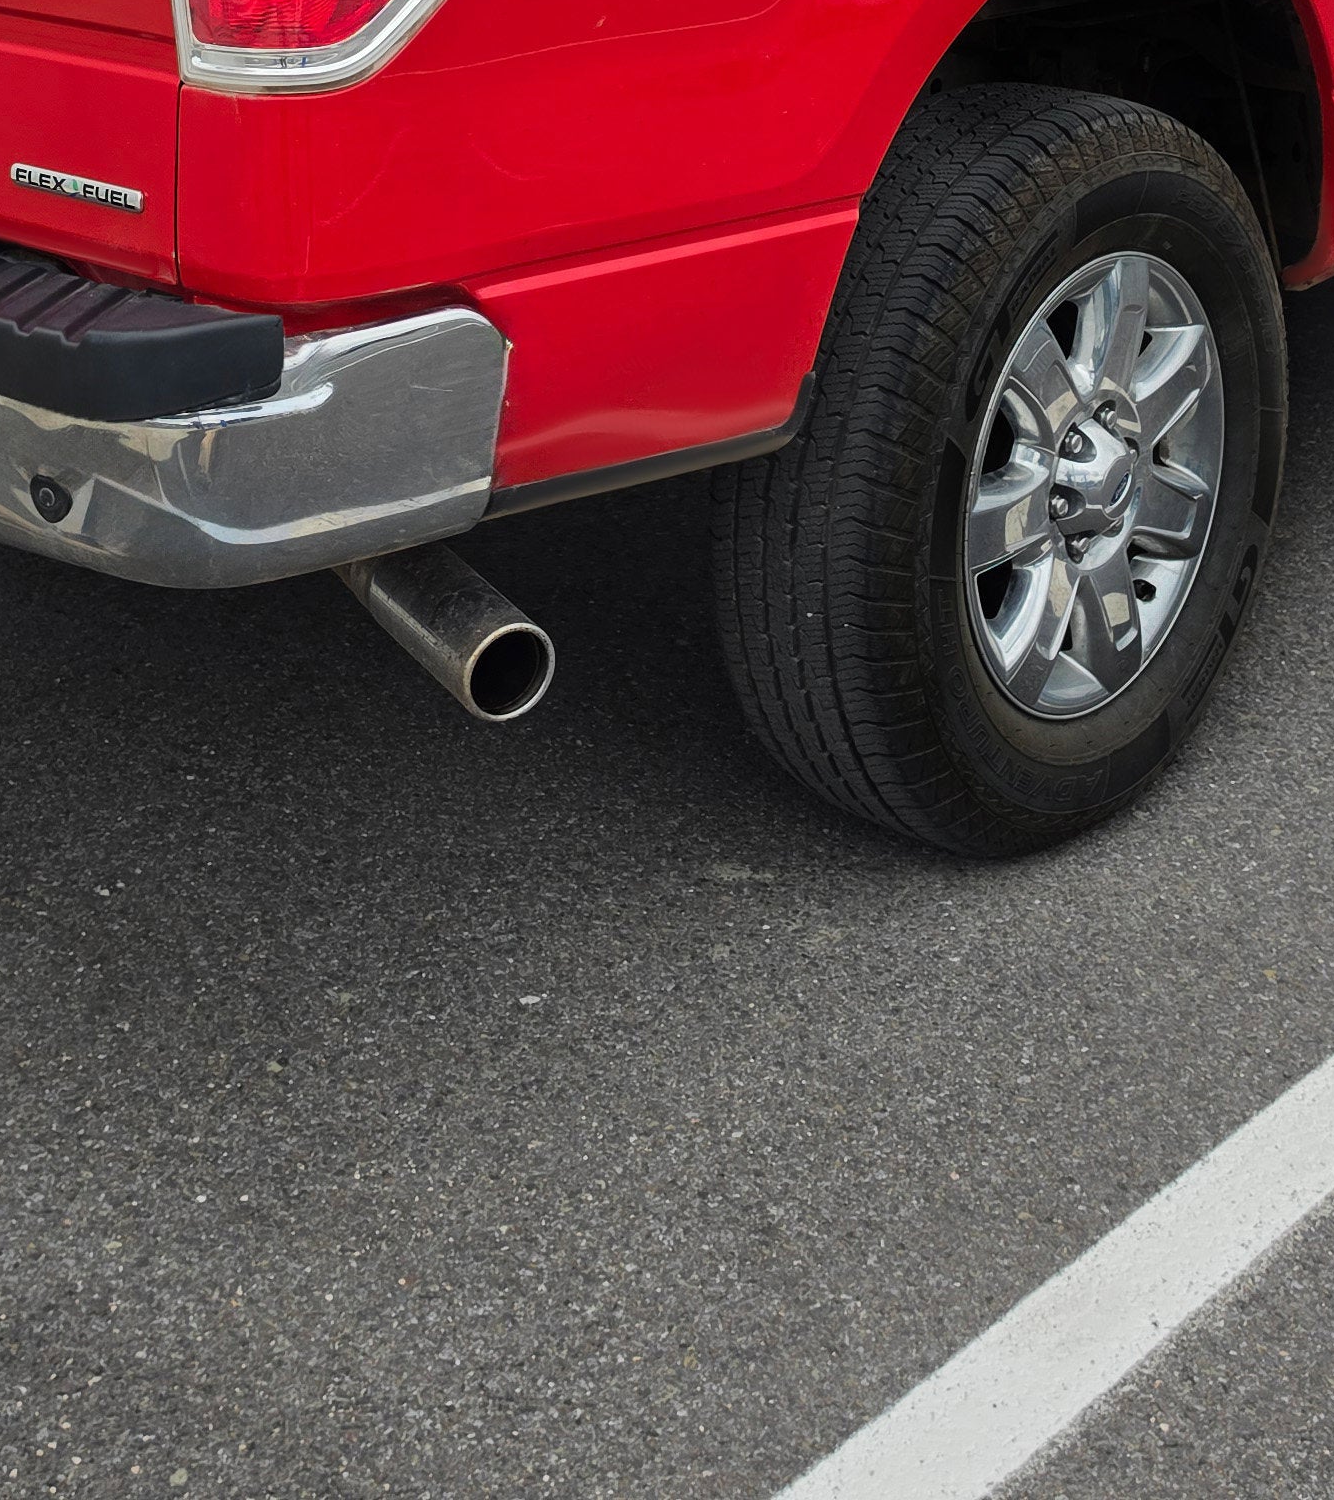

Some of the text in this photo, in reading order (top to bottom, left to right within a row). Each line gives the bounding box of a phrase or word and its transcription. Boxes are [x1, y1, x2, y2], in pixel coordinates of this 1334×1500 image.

[15, 167, 135, 210] FLEX FUEL
[937, 583, 1107, 802] ADVENTURO HT
